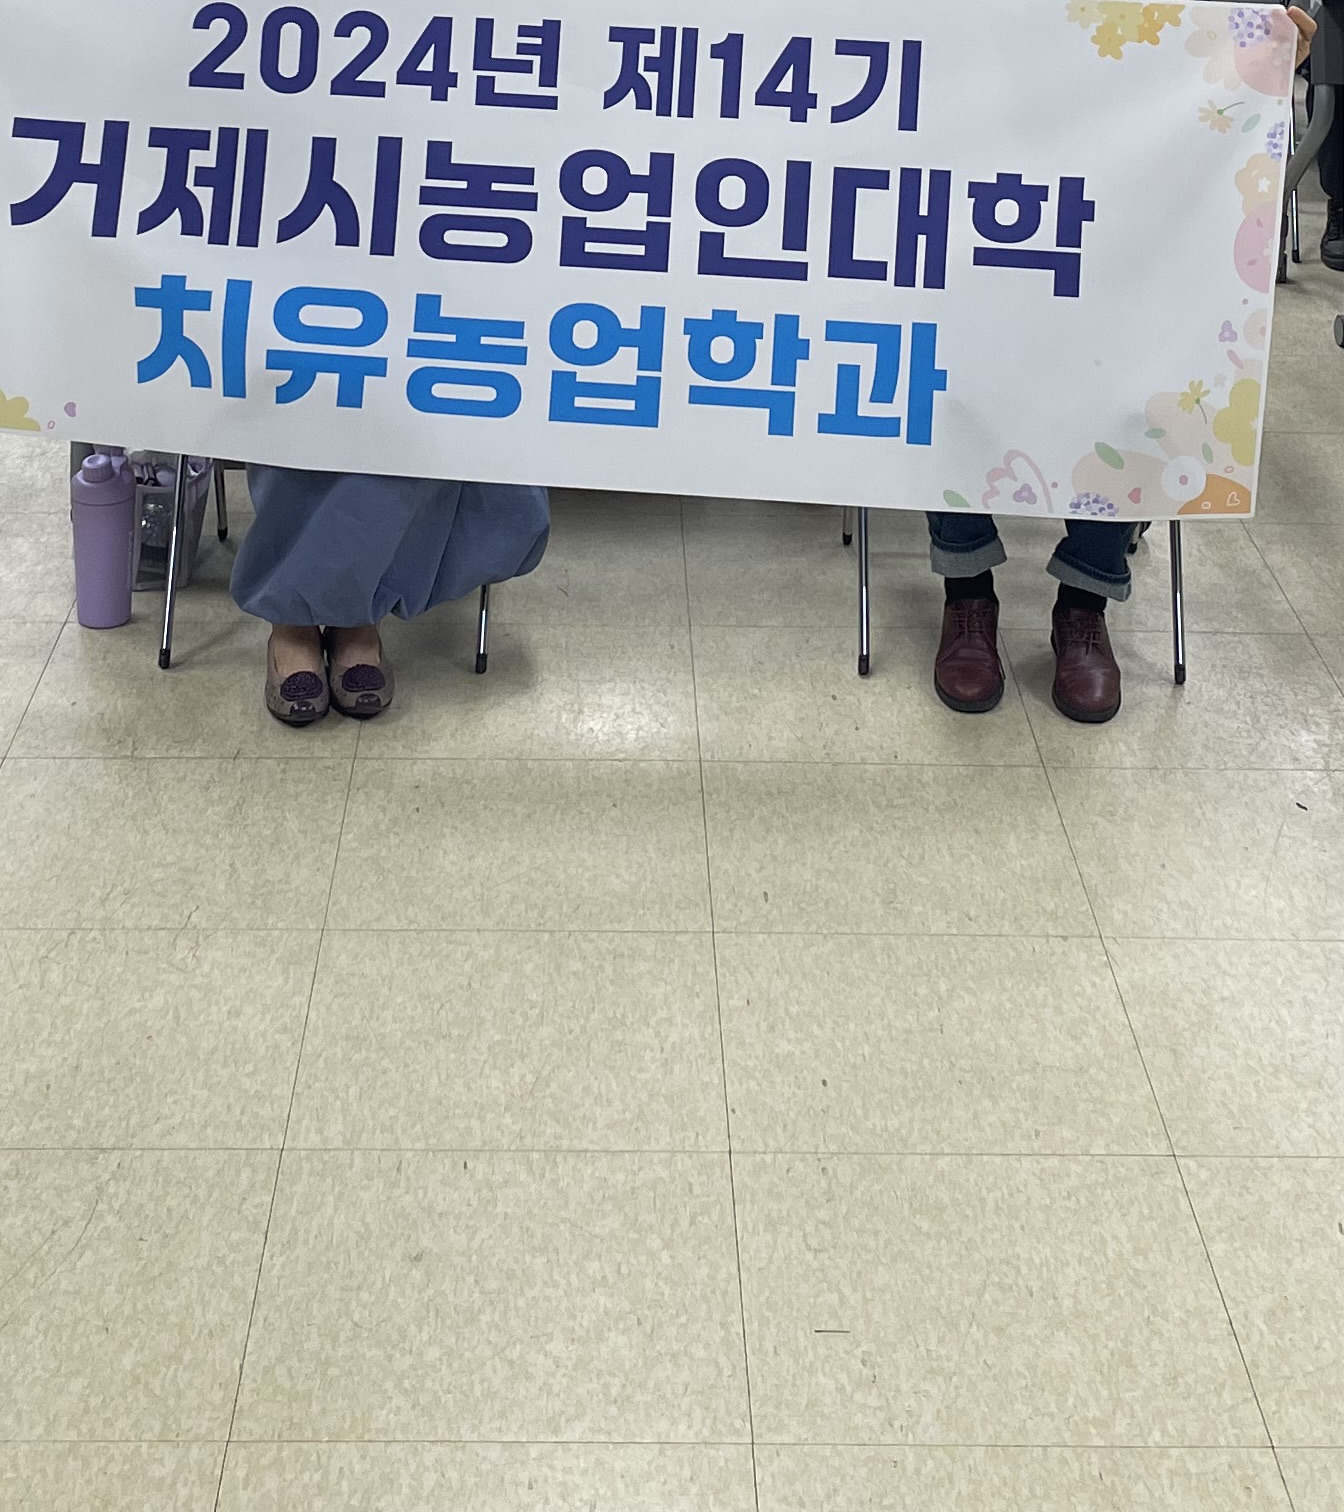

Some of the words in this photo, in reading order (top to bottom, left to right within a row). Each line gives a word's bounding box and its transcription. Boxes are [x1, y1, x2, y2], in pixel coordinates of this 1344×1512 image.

[189, 2, 561, 110] 2024년
[603, 26, 922, 132] 제14기
[9, 117, 1096, 298] 거제시농업인대학
[132, 272, 950, 448] 치유농업학과
